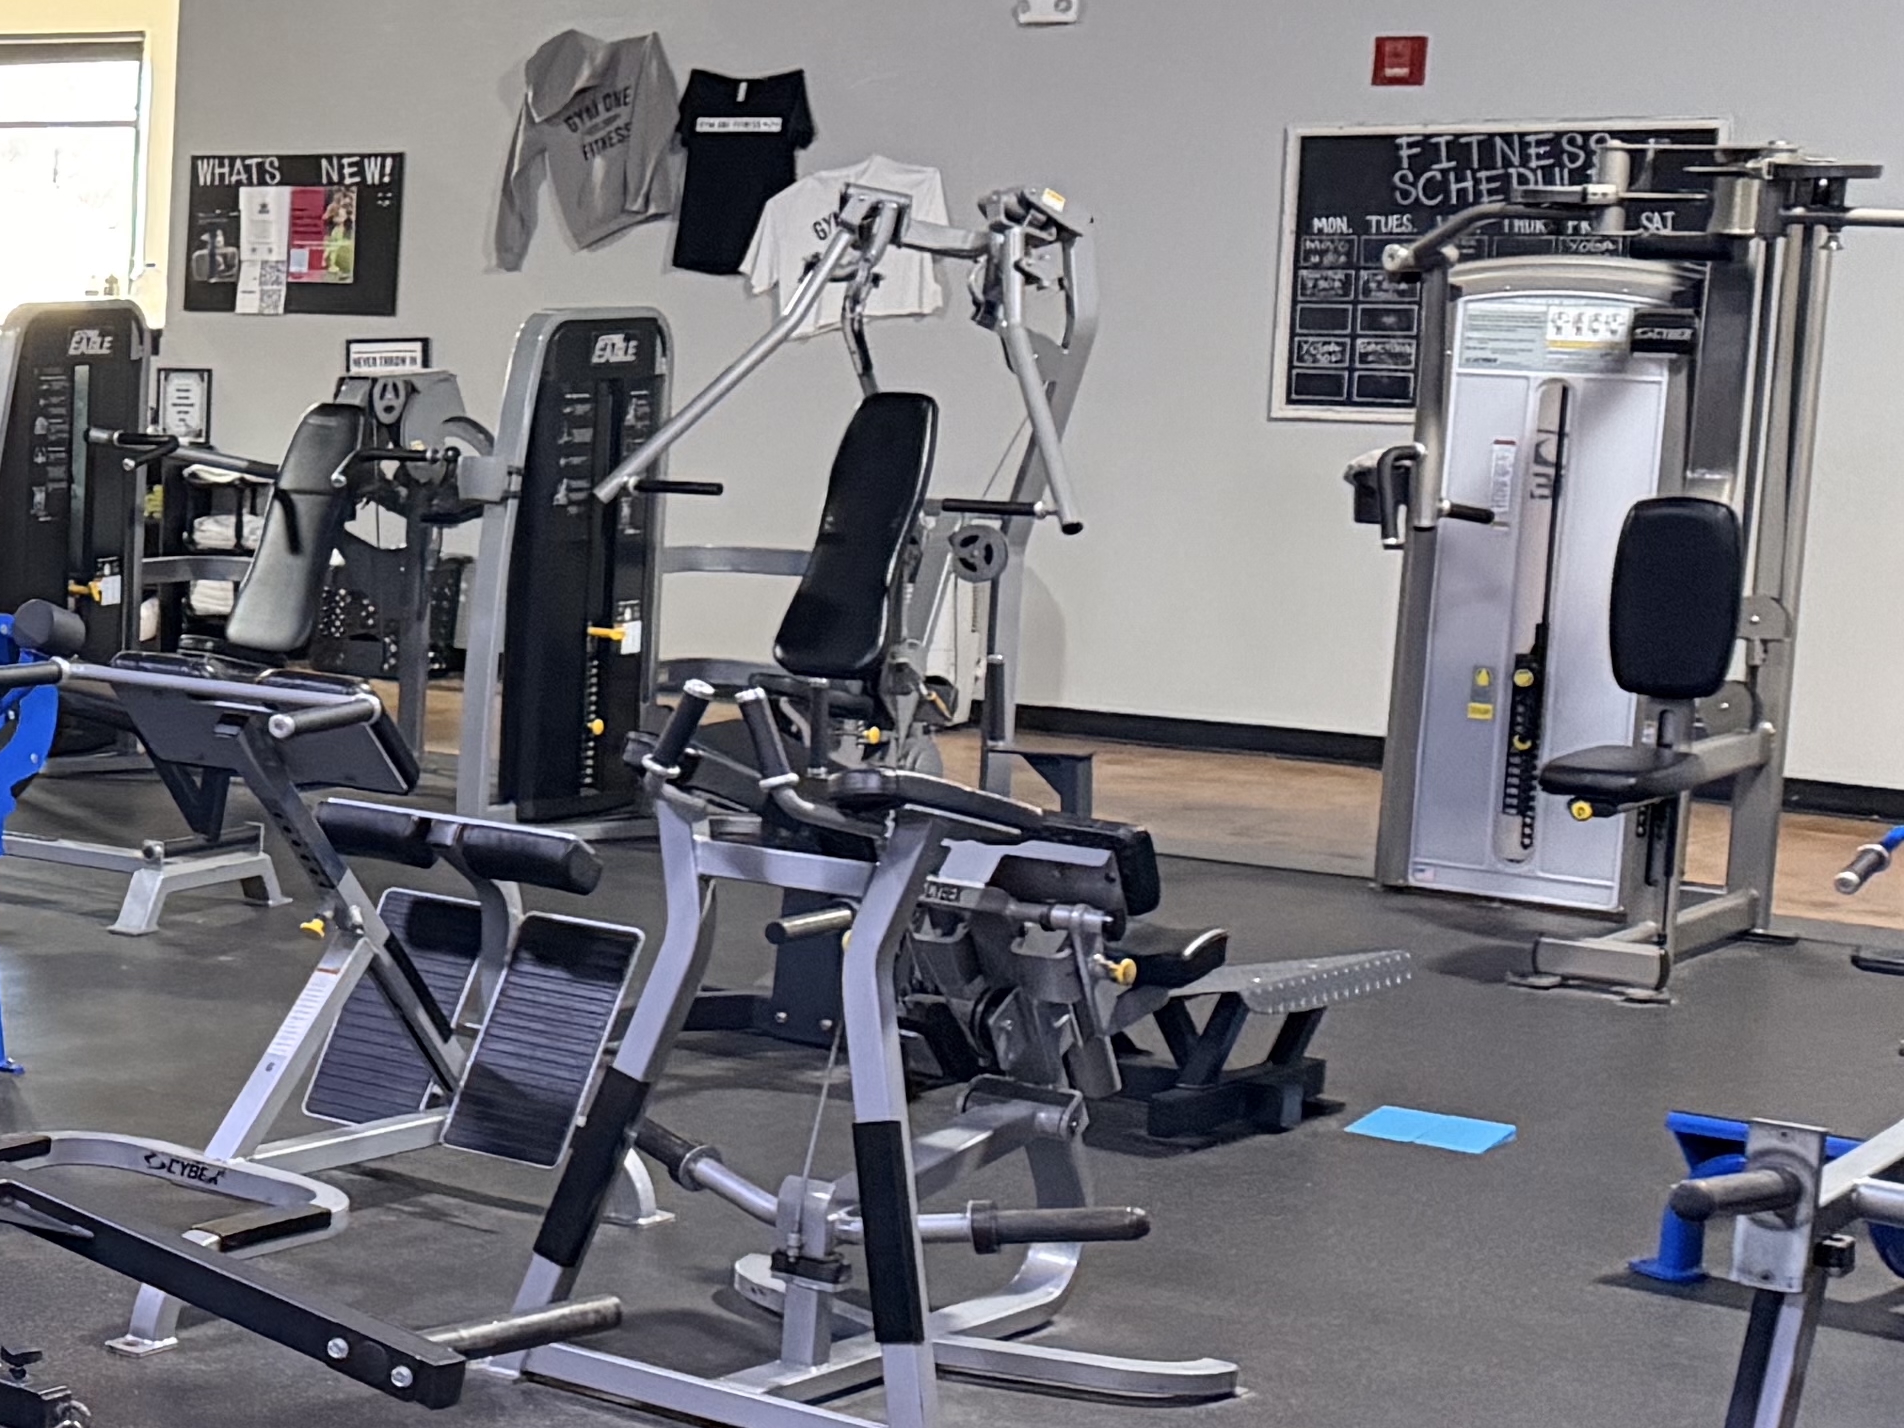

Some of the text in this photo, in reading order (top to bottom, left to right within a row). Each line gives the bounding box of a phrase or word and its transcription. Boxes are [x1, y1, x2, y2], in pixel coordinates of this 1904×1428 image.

[563, 85, 632, 134] GYM ONE
[582, 122, 633, 161] FITNESS
[196, 155, 393, 186] WHATS NEW!
[1313, 215, 1354, 234] MON.
[1365, 214, 1418, 234] TUES.
[1640, 211, 1676, 234] SAT
